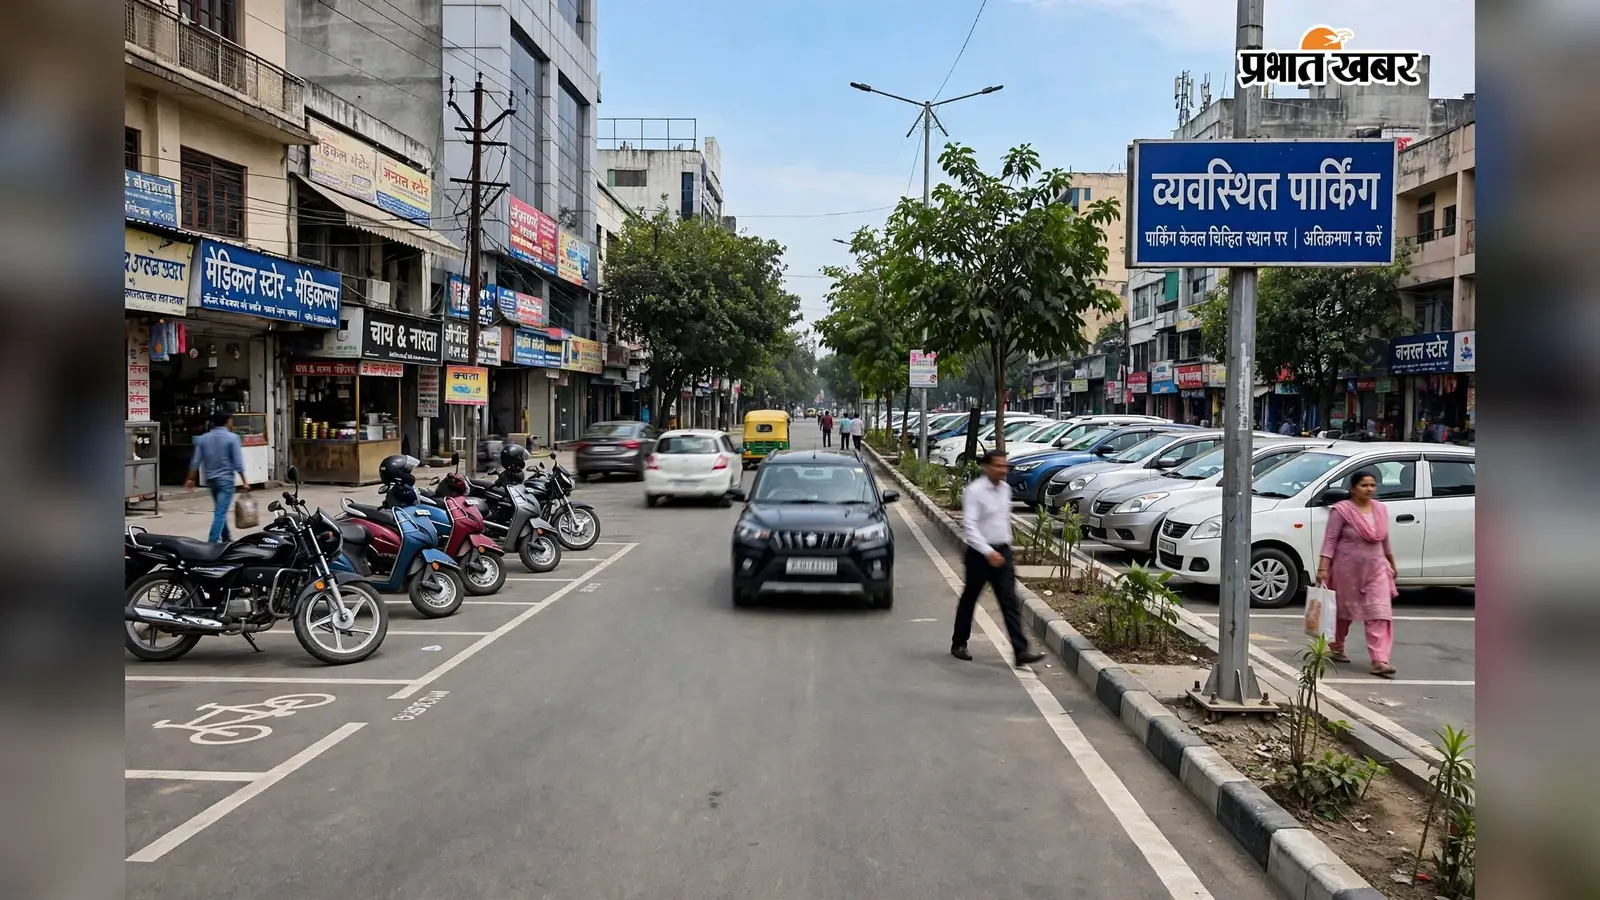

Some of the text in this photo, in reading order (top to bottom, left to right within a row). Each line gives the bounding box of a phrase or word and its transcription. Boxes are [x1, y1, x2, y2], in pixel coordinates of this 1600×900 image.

[1151, 158, 1381, 211] व्यवस्थित पार्किंग
[1145, 226, 1177, 247] पार्किंग
[1179, 226, 1207, 247] केवल
[1208, 225, 1243, 249] चिन्हित
[1246, 231, 1271, 247] स्थान
[1274, 231, 1288, 247] पर
[1303, 225, 1352, 247] अतिक्रमण
[1353, 231, 1362, 247] न
[1365, 225, 1383, 247] करें
[205, 246, 257, 296] मेडिकल
[259, 263, 285, 300] स्टोर
[370, 321, 394, 347] चाय
[397, 325, 406, 348] &
[410, 328, 438, 352] नाश्ता
[1425, 334, 1449, 359] स्टोर
